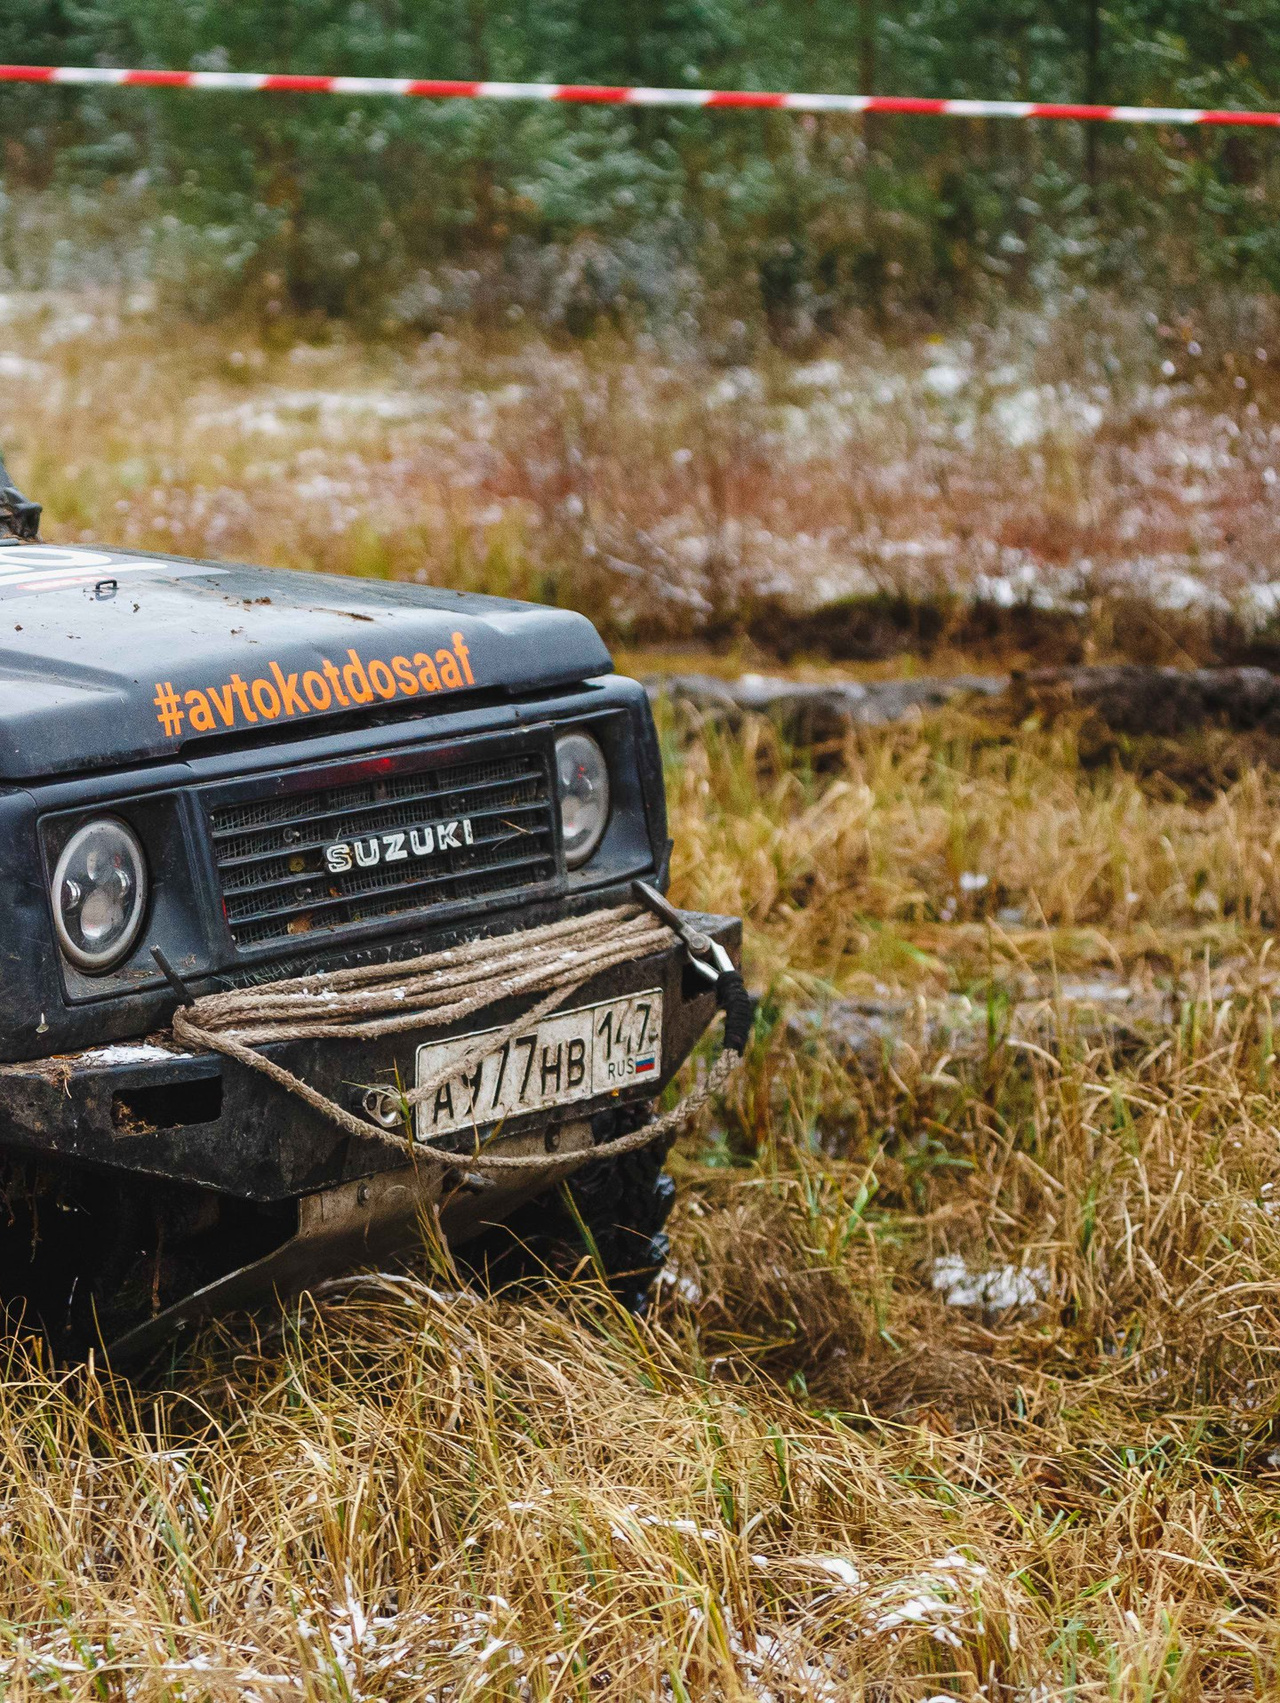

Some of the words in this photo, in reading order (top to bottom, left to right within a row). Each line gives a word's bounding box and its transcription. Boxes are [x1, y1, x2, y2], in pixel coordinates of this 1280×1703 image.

[153, 632, 475, 737] #avtokotdosaaf
[325, 819, 474, 874] SUZUKI
[598, 1001, 652, 1061] 147
[608, 1058, 635, 1081] RUS
